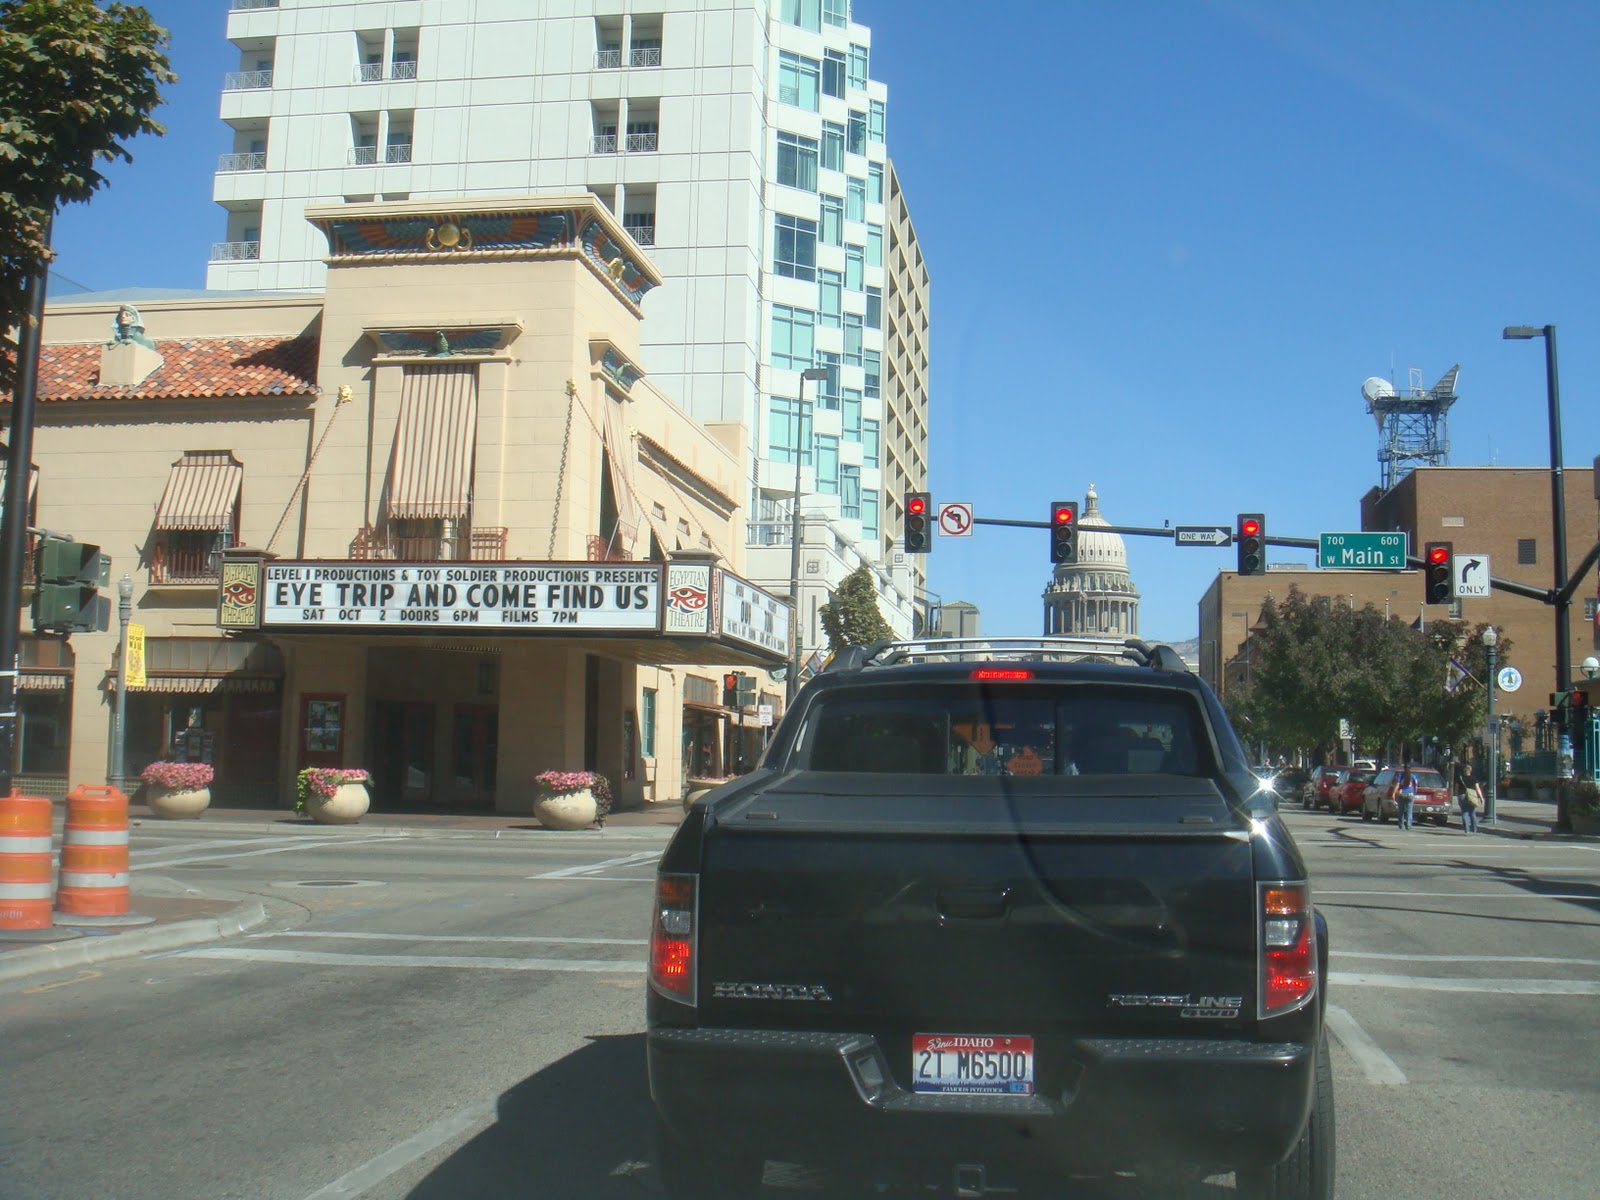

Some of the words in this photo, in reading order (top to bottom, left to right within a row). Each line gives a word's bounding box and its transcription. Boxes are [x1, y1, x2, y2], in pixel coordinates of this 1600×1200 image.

[1180, 532, 1196, 540] ONE
[1200, 533, 1216, 541] WAY
[1327, 536, 1345, 546] 700
[1380, 536, 1399, 546] 600
[1327, 555, 1335, 565] W
[1341, 547, 1383, 565] Main
[1389, 555, 1399, 565] St
[268, 568, 301, 580] LEVEL
[314, 569, 396, 581] PRODUCTIONS
[401, 569, 408, 580] &
[417, 569, 440, 581] TOY
[446, 569, 497, 582] SOLDIER
[504, 570, 590, 583] PRODUCTIONS
[595, 571, 659, 583] PRESENTS
[670, 570, 708, 588] EGYPTIAN
[276, 583, 322, 606] EYE
[336, 584, 394, 606] TRIP
[407, 584, 457, 607] AND
[466, 584, 536, 608] COME
[547, 585, 604, 609] FIND
[615, 586, 649, 609] US
[1459, 585, 1485, 594] ONLY
[303, 609, 325, 620] SAT
[339, 610, 361, 620] OCT
[379, 610, 386, 621] 2
[400, 610, 440, 622] DOORS
[453, 611, 479, 622] 6PM
[502, 611, 539, 623] FILMS
[552, 612, 578, 623] 7PM
[669, 610, 705, 628] THEATRE
[712, 982, 833, 1000] HONDA
[1182, 1009, 1238, 1018] 4WD
[954, 1038, 994, 1048] IDAHO
[919, 1050, 946, 1079] 2T
[957, 1050, 1027, 1081] M6500
